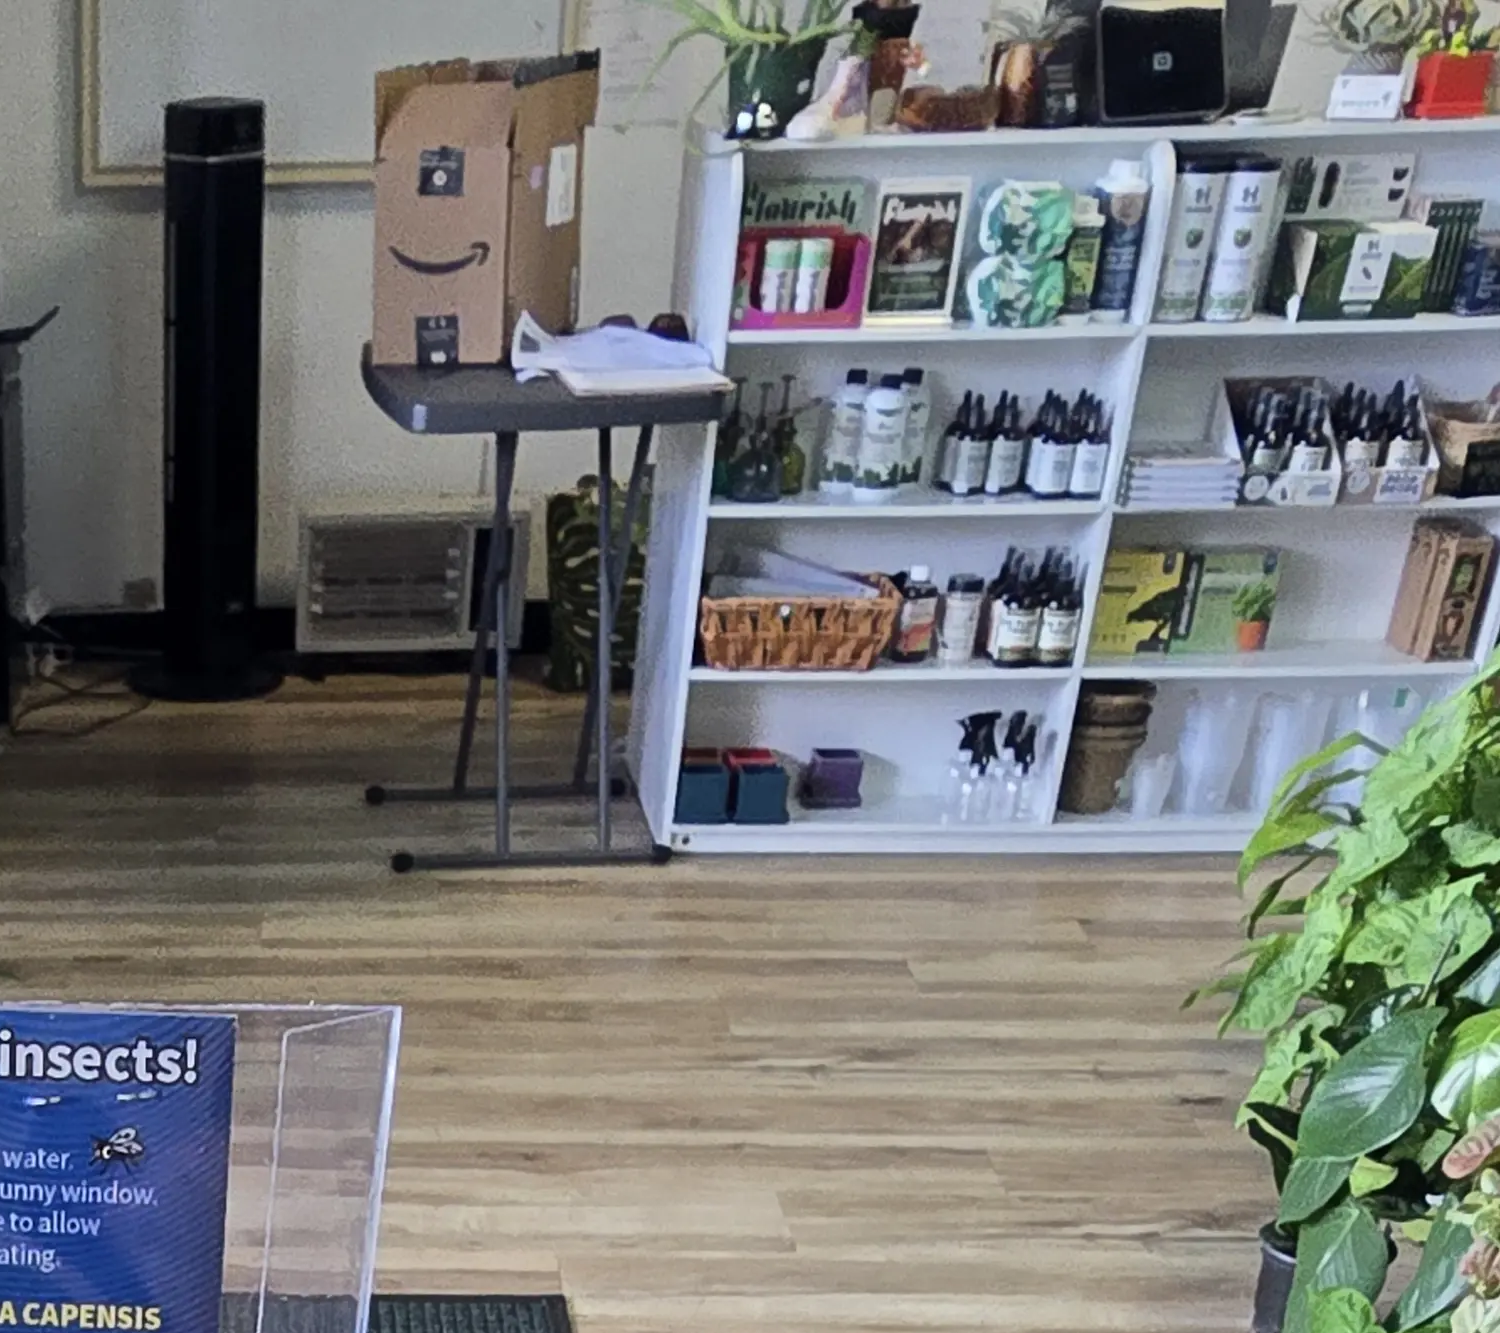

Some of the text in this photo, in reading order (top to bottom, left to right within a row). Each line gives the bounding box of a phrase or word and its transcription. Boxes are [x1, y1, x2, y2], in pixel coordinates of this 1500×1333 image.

[0, 1029, 198, 1084] insects!
[2, 1149, 74, 1170] water.
[61, 1180, 159, 1206] window.
[9, 1212, 33, 1233] to
[38, 1211, 101, 1236] allow
[22, 1302, 162, 1331] CAPENSIS
